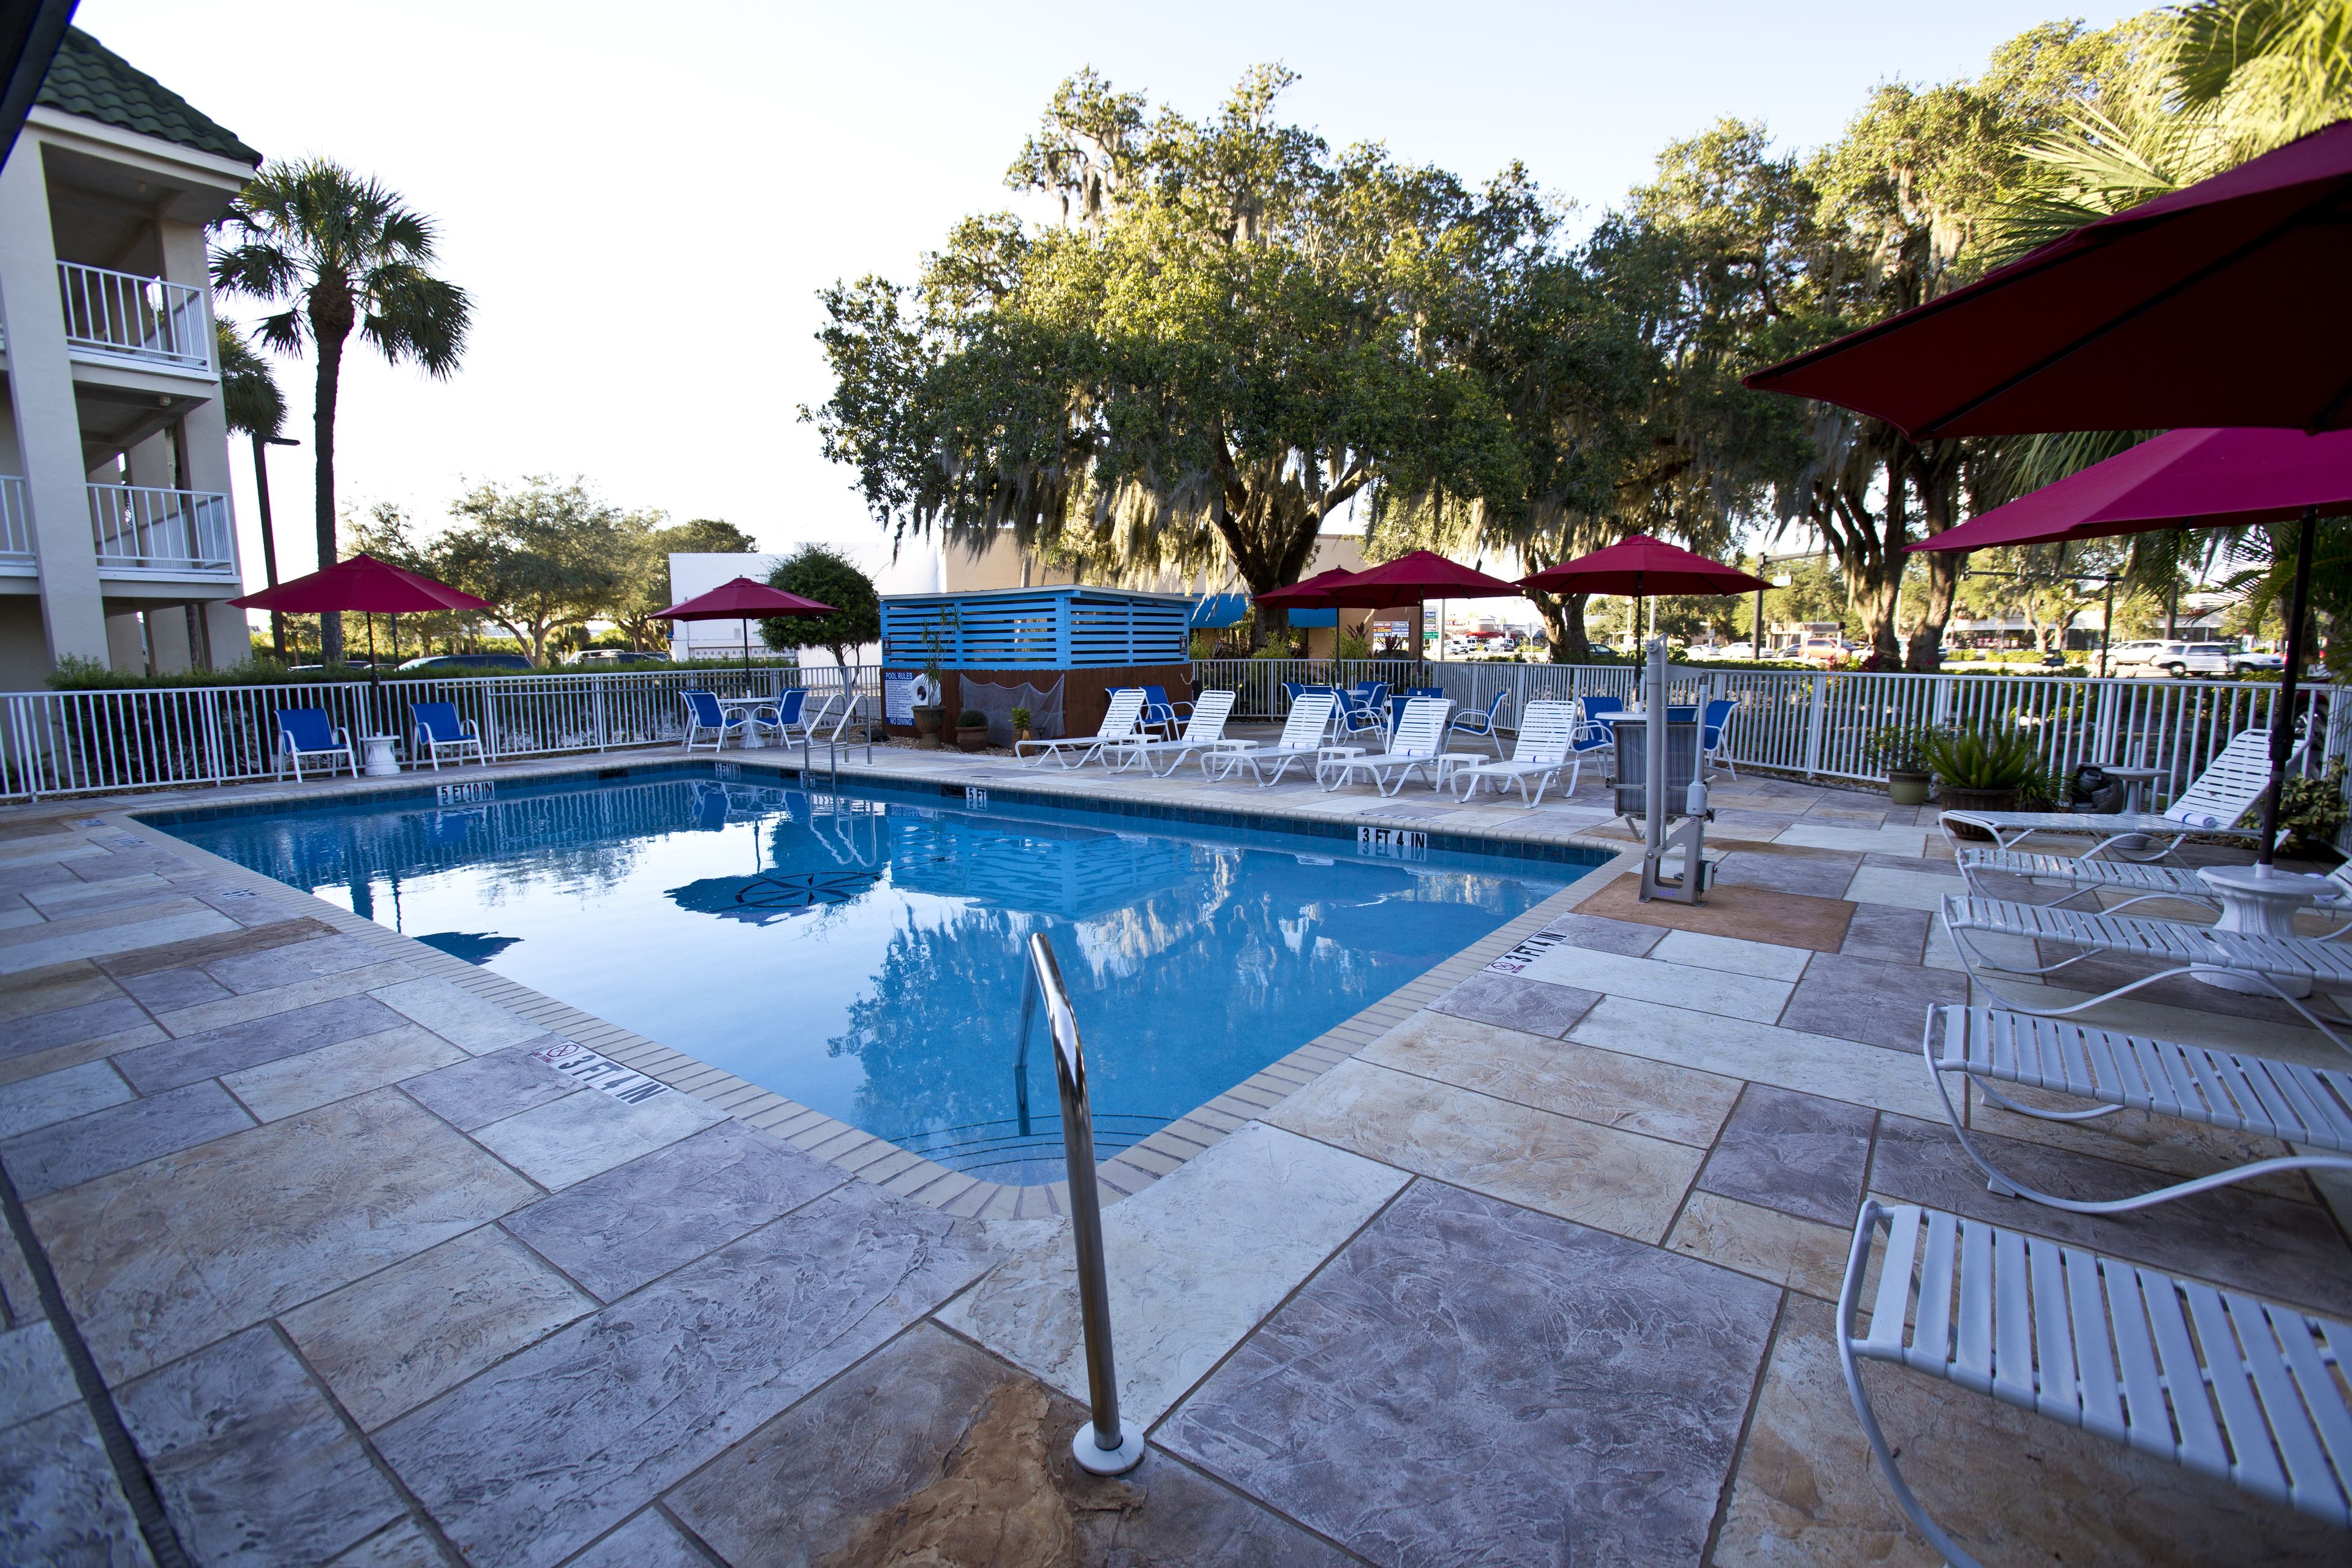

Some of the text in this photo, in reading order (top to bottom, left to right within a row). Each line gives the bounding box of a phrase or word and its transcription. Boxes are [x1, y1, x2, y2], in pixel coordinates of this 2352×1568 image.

[969, 788, 973, 799] 5
[1363, 827, 1425, 848] 3 FT 4 IN
[1512, 945, 1547, 957] FT
[1534, 931, 1567, 942] IN
[537, 1055, 554, 1063] DIVING
[558, 1055, 669, 1104] 3 FT 4 IN
